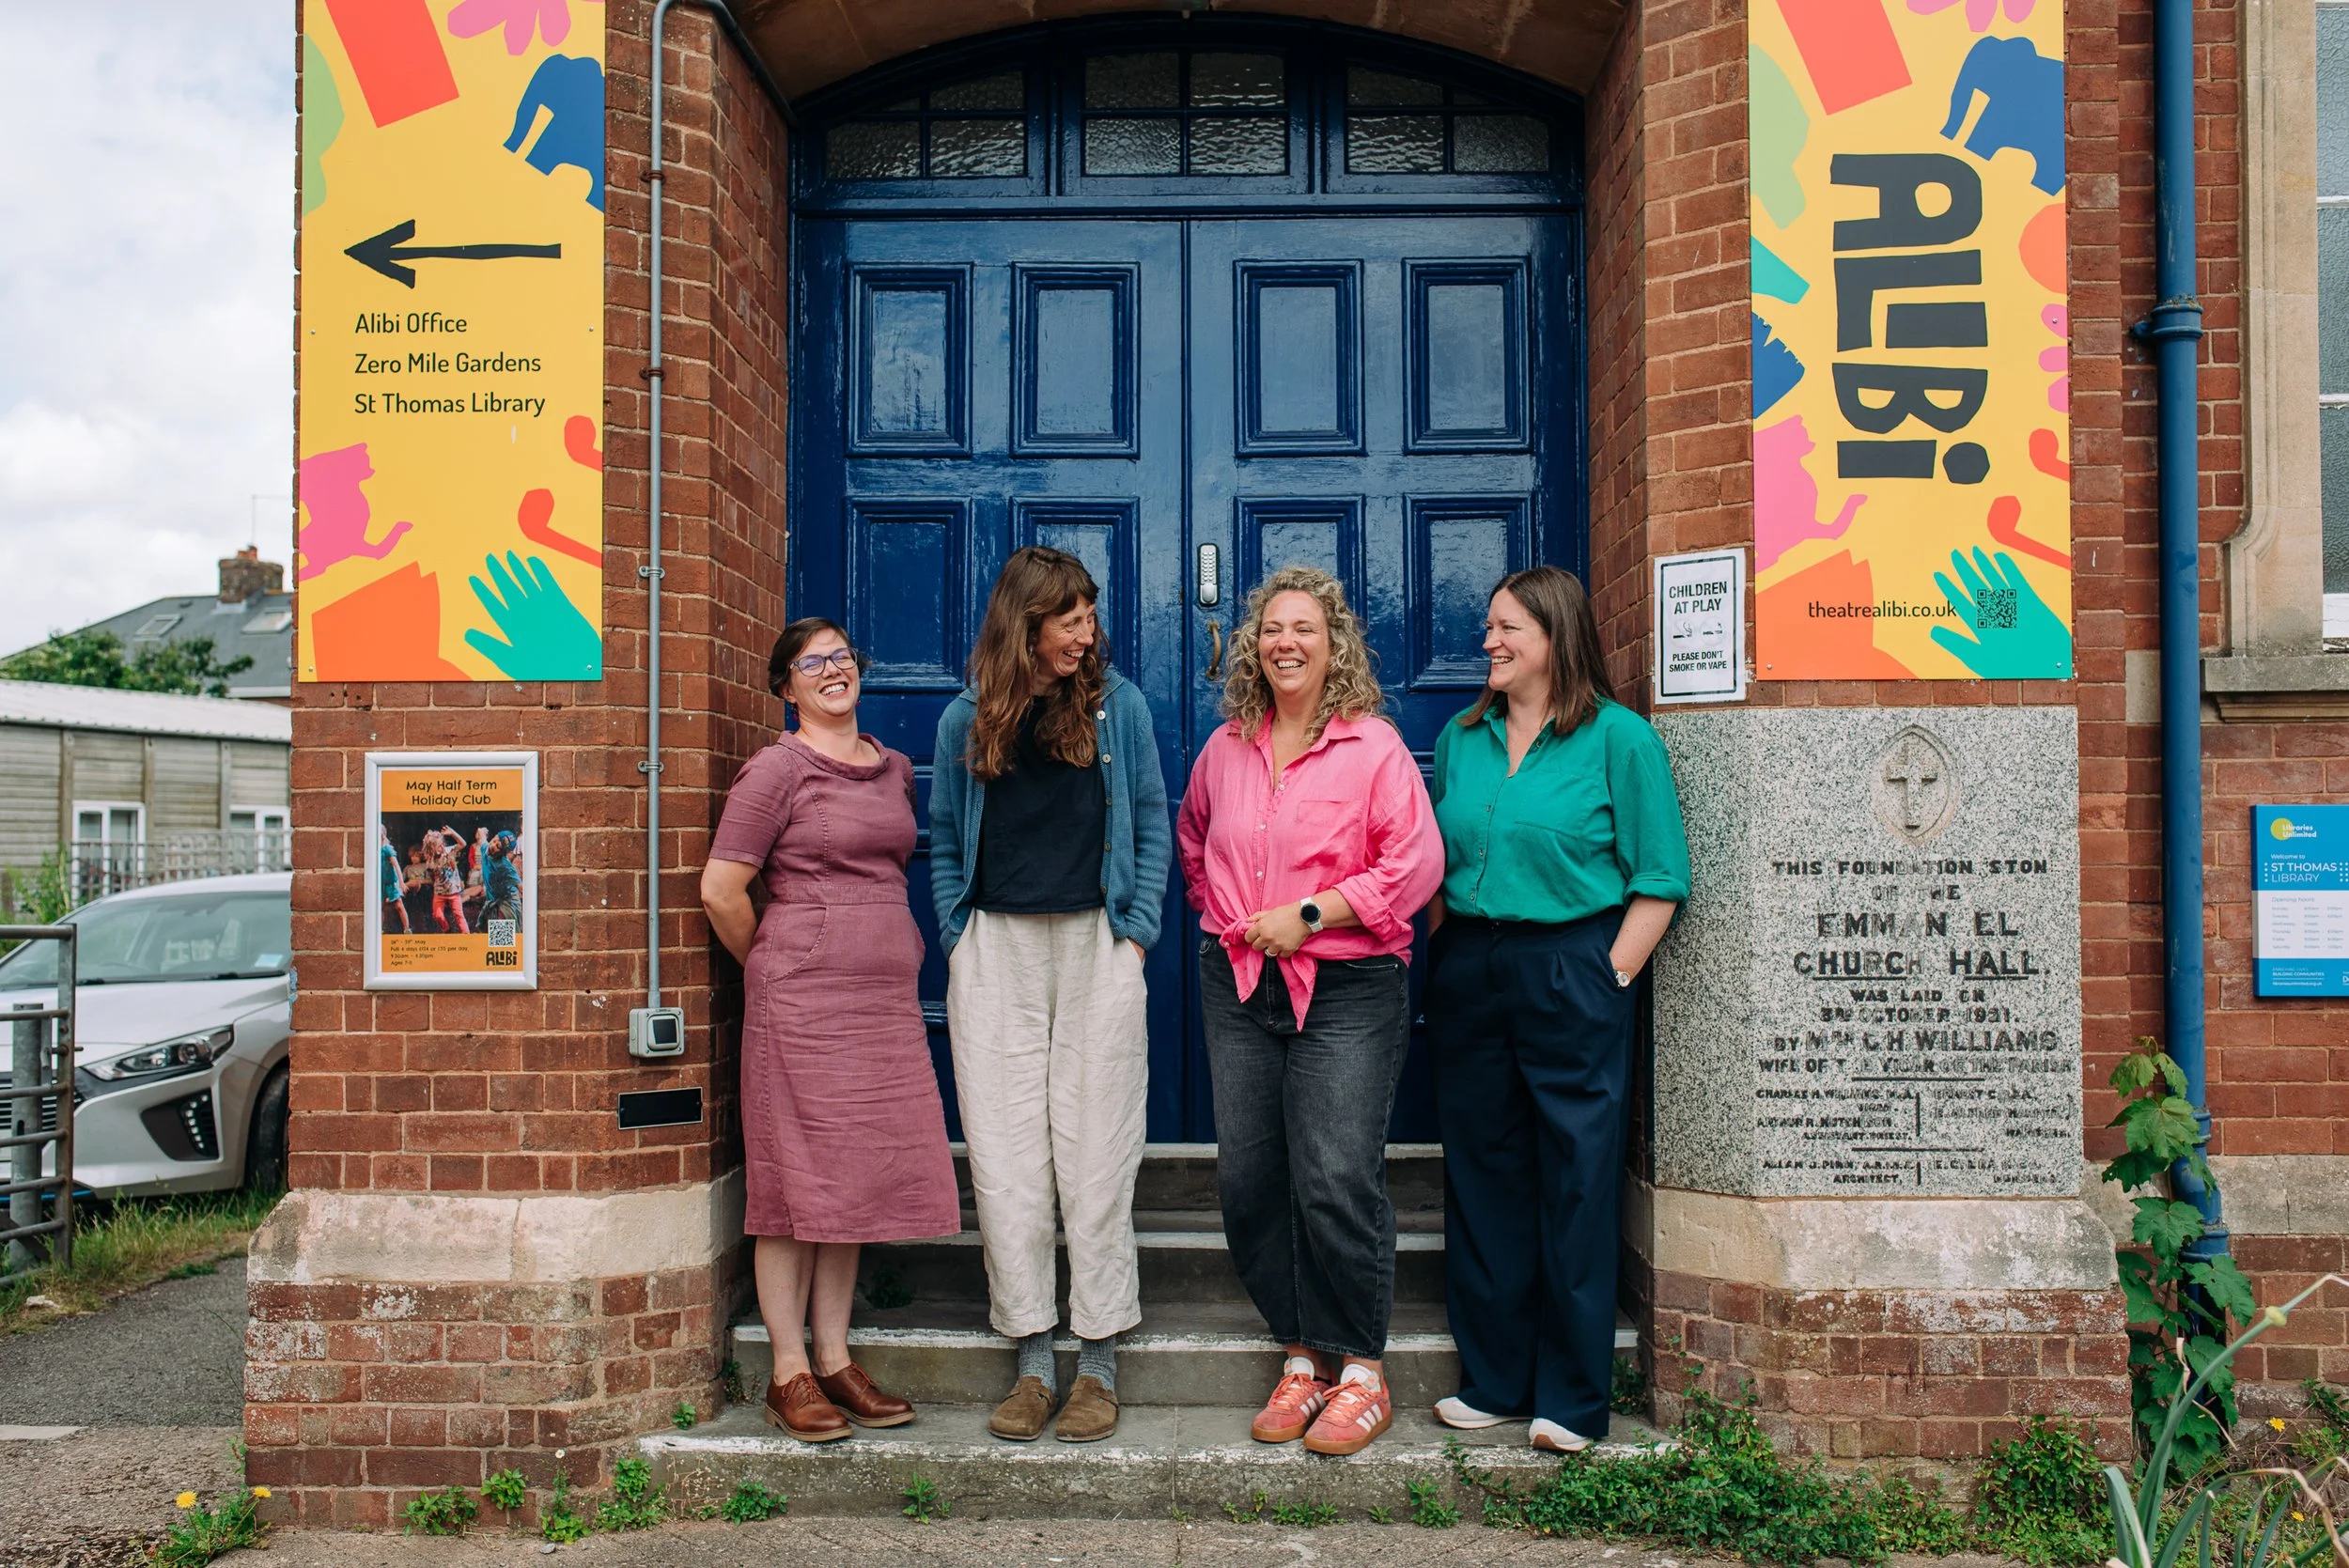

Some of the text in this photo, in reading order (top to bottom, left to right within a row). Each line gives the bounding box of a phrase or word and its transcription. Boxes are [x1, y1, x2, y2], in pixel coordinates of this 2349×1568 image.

[355, 312, 467, 334] Alibi Office
[354, 351, 541, 374] Zero Mile Gardens
[354, 392, 546, 418] St Thomas Library
[1669, 582, 1728, 598] CHILDREN
[1674, 598, 1722, 614] AT PLAY
[1808, 600, 1957, 618] theatrealibi.co.uk
[1672, 650, 1723, 661] PLEASE DON'T
[1669, 660, 1727, 673] SMOKE OR VAPE
[406, 779, 497, 793] May Half Term
[412, 794, 491, 807] Holiday Club
[1772, 861, 1823, 875] THIS
[2271, 862, 2338, 872] ST THOMAS
[2271, 873, 2320, 882] LIBRARY
[1794, 951, 1922, 975] CHURCH
[1849, 989, 1986, 1002] WAS LAID ON
[1859, 1007, 1951, 1022] OCTOBER
[1775, 1037, 1798, 1051] BY
[1914, 1031, 2058, 1051] WILLIAMS
[1759, 1059, 1799, 1073] WIFE
[1805, 1059, 1828, 1073] OF
[1755, 1089, 1808, 1099] CHARLES
